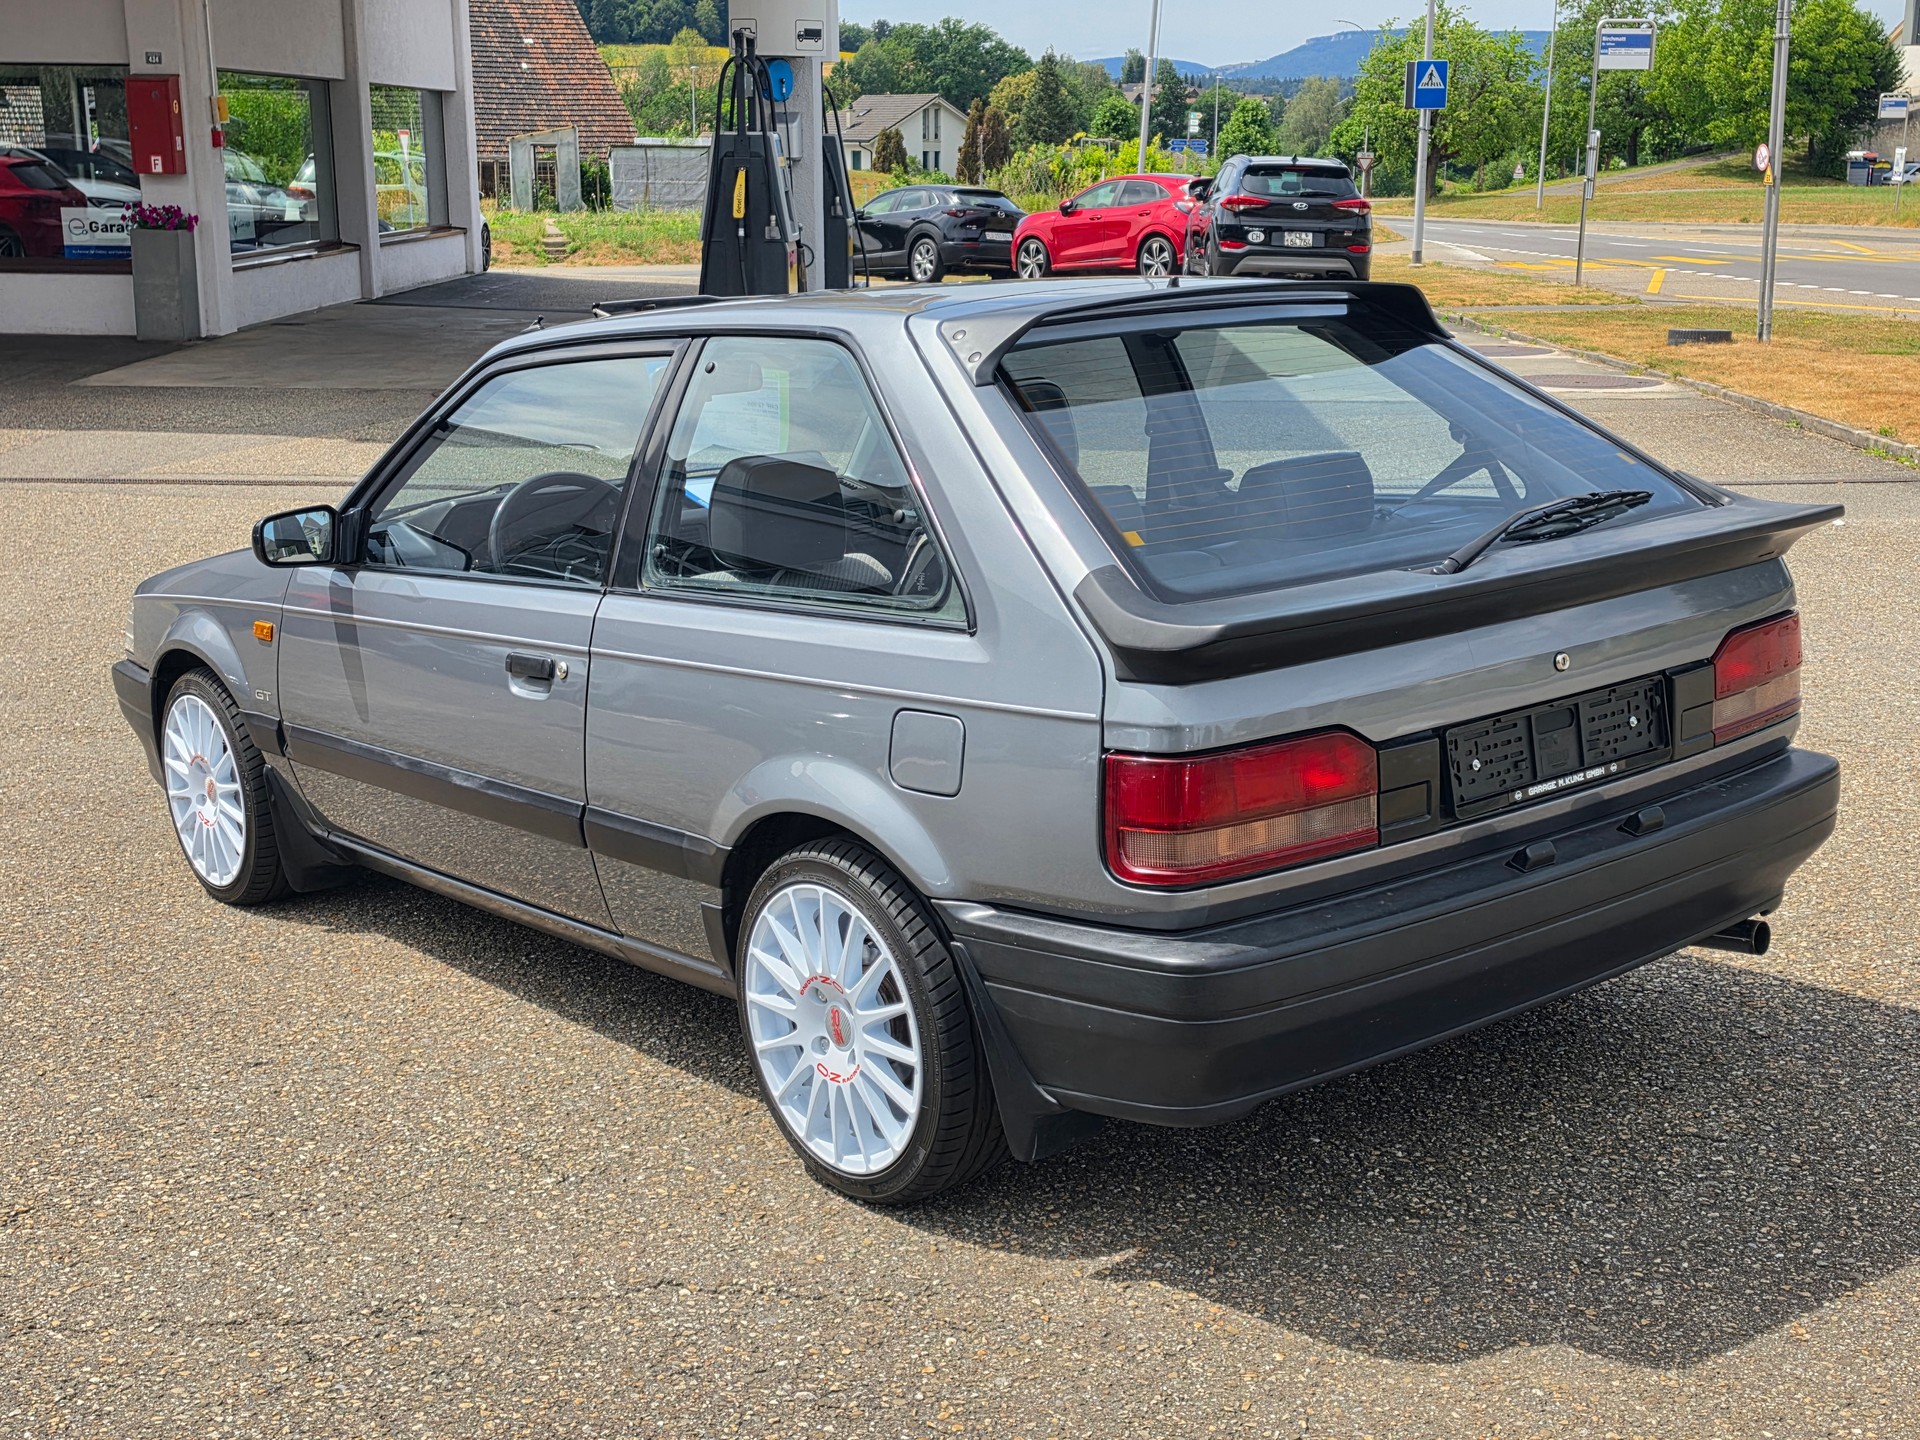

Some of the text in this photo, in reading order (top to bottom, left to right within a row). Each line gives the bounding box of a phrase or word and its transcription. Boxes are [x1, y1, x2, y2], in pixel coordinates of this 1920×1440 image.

[152, 158, 160, 171] F
[255, 689, 272, 701] GT
[1528, 766, 1605, 796] GARAGE M.KUNZ GMBH
[800, 975, 819, 996] RACING
[842, 1063, 861, 1084] RACING
